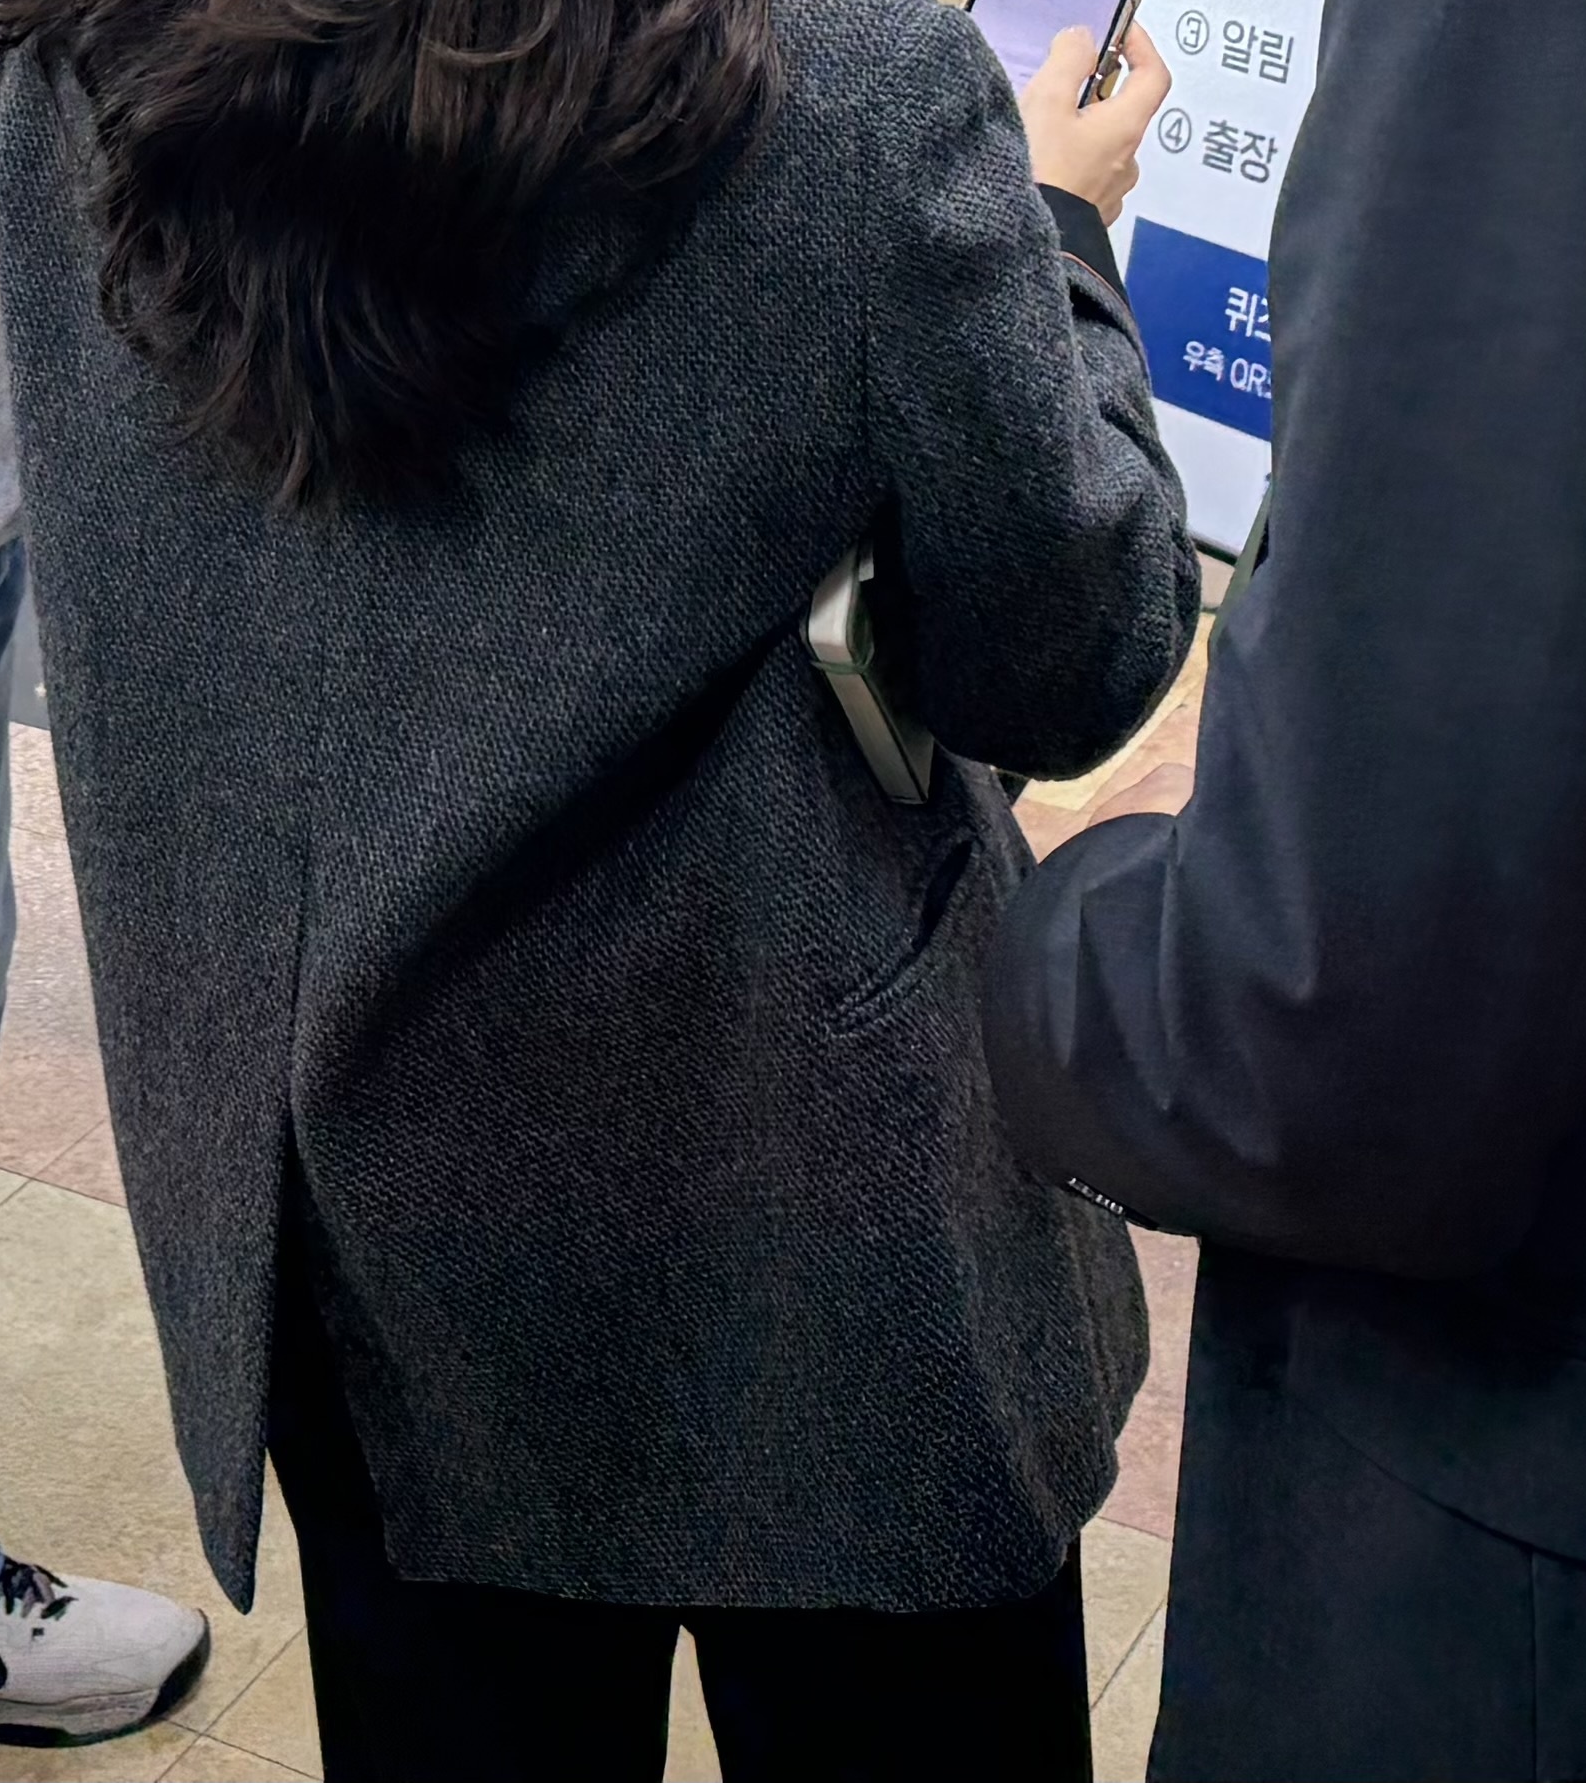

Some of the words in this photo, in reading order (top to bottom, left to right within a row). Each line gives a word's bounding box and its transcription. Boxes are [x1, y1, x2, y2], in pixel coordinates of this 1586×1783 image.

[1220, 19, 1294, 86] 알림
[1201, 118, 1279, 185] 출장
[1182, 340, 1225, 382] 우측
[1230, 357, 1272, 400] QR
